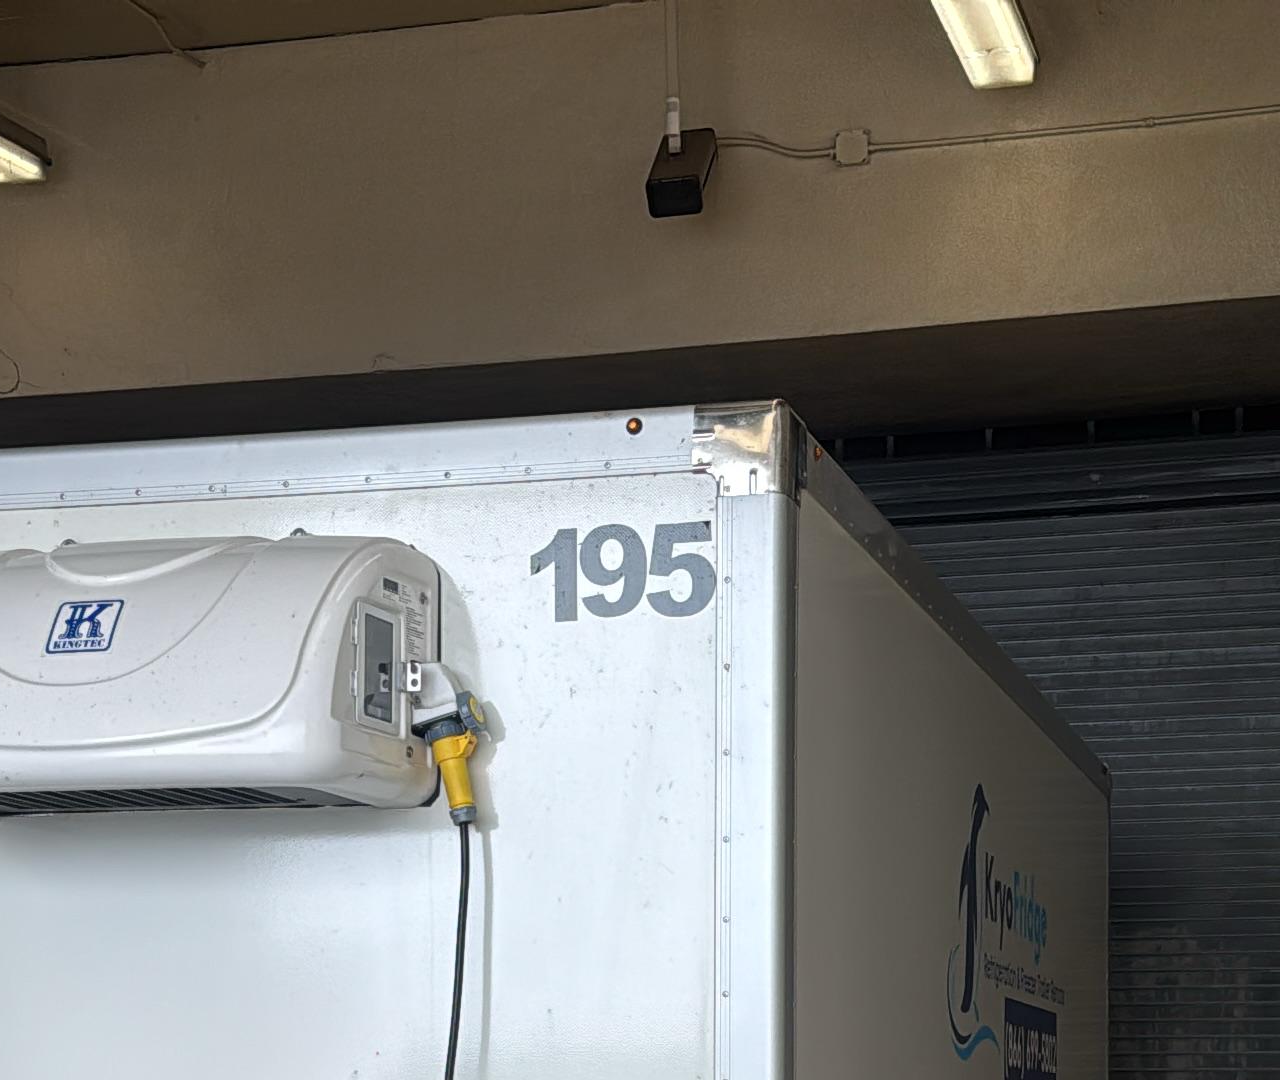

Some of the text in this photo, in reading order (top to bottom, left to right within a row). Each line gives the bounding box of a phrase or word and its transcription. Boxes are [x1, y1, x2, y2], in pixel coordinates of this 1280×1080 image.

[530, 520, 717, 623] 195
[53, 639, 106, 650] KINGTEC
[984, 851, 1048, 966] KryoFridge
[1005, 1021, 1025, 1080] (866)
